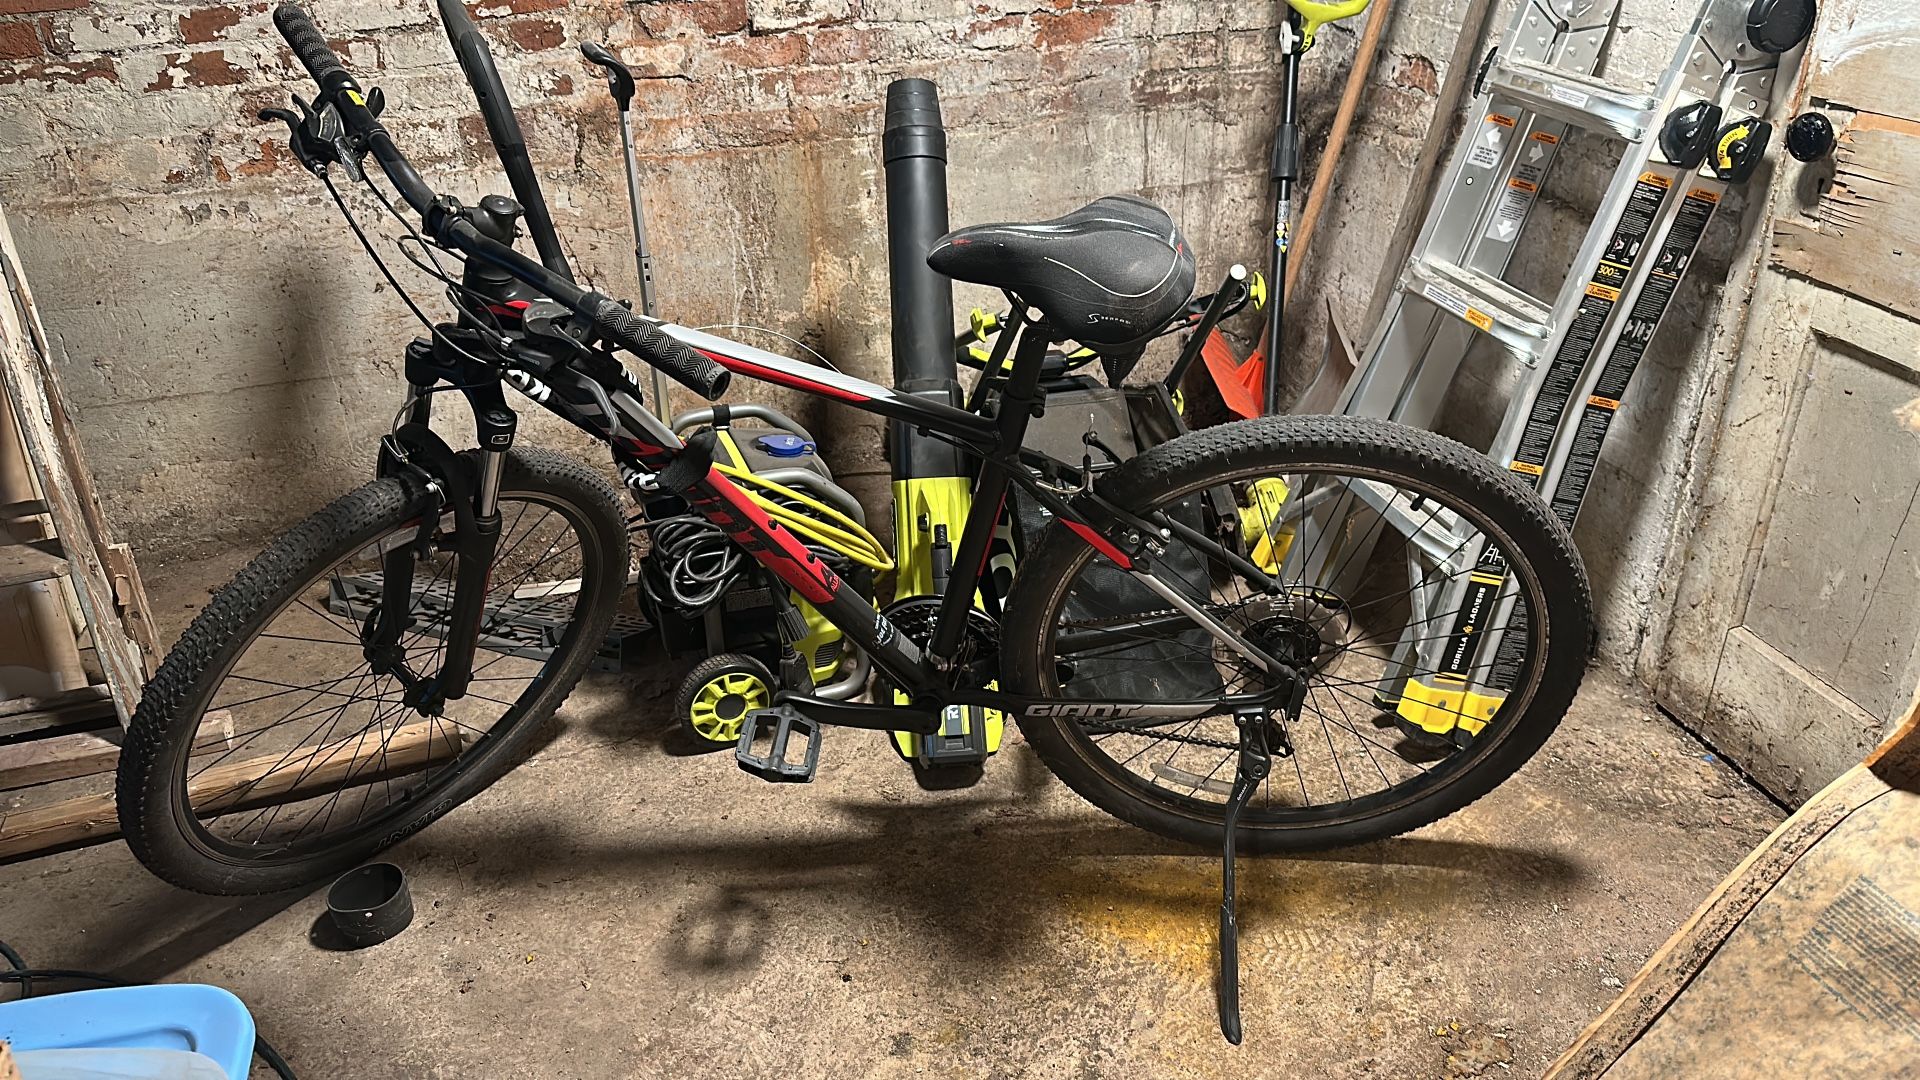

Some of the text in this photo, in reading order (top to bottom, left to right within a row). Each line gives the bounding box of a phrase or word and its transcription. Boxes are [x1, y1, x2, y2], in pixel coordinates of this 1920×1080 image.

[1721, 131, 1738, 147] TURN
[1598, 264, 1614, 276] 300
[1451, 636, 1469, 670] GORILLA
[1024, 704, 1143, 717] GIANT
